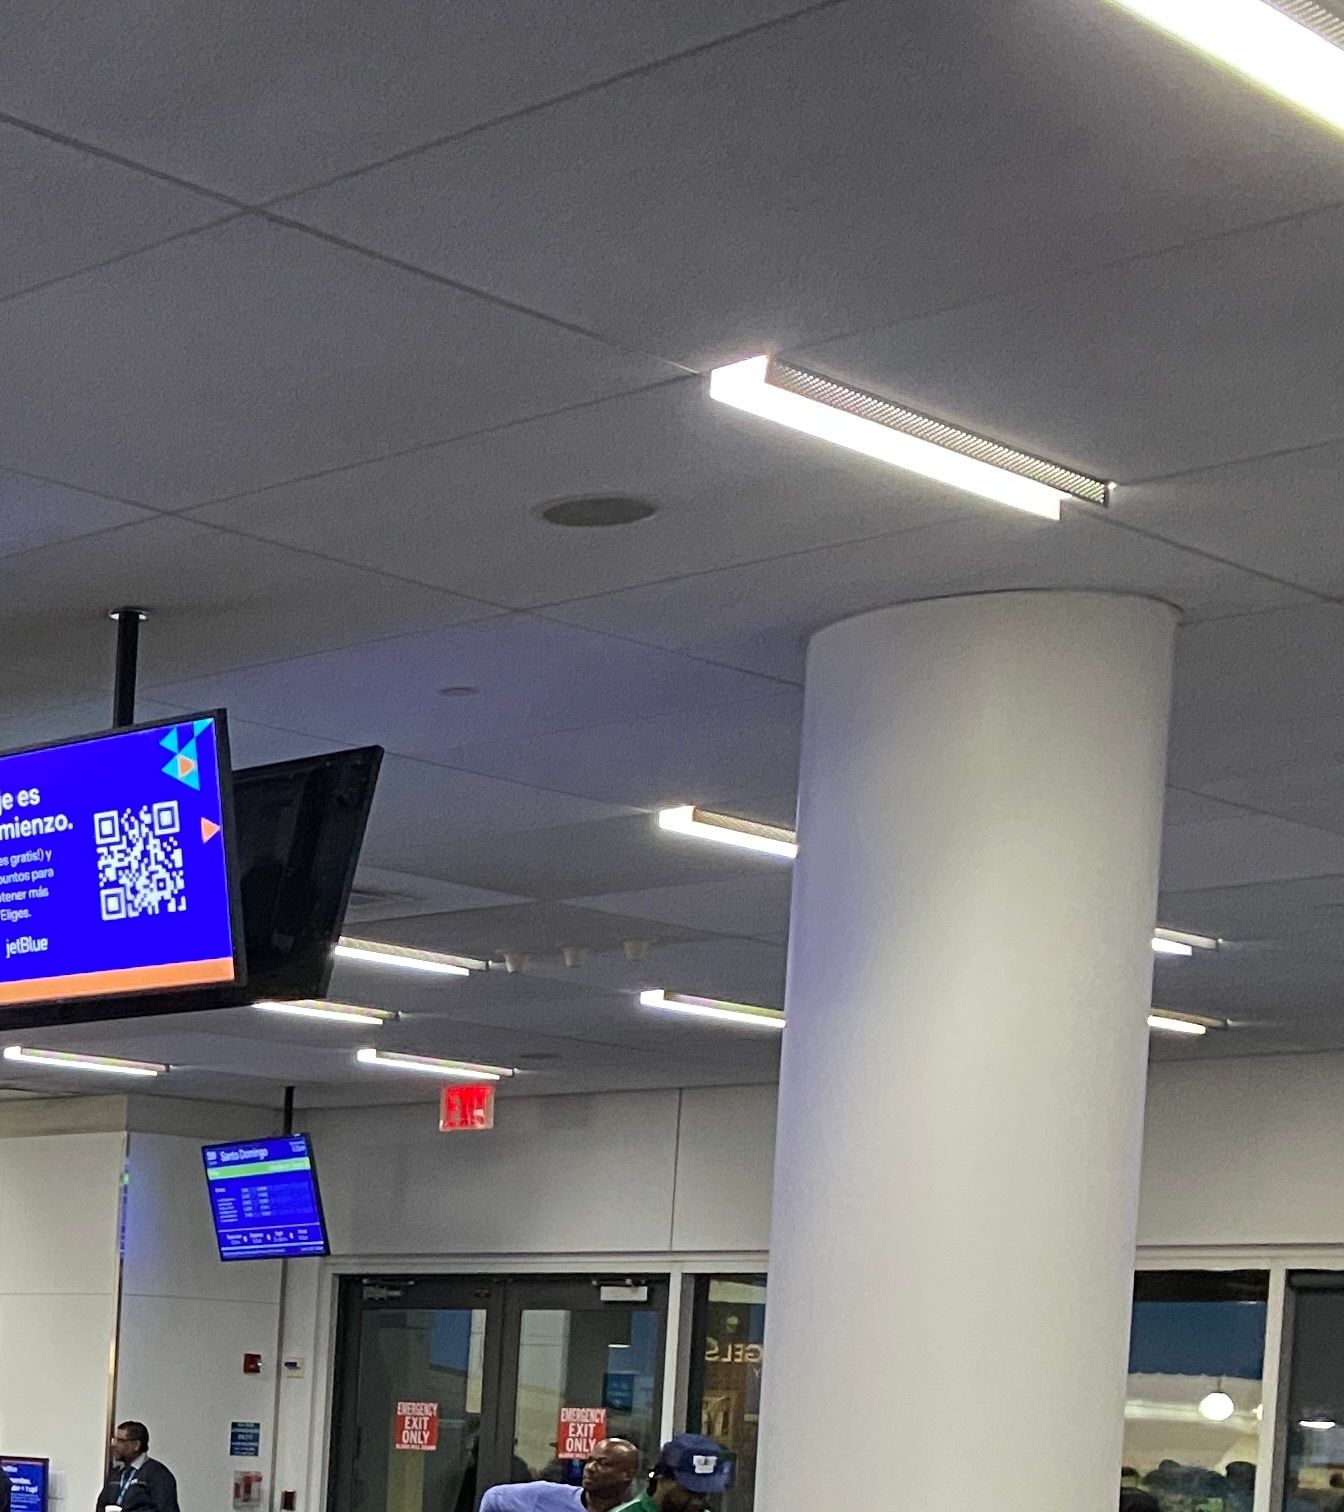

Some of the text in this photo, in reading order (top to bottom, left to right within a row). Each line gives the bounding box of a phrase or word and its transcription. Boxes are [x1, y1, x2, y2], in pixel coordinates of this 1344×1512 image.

[17, 788, 41, 807] es
[10, 848, 44, 867] gratis!)
[45, 850, 52, 862] y
[31, 868, 55, 882] para
[28, 885, 50, 898] más
[0, 908, 32, 922] Eliges.
[5, 935, 49, 958] jetBlue
[397, 1402, 438, 1416] EMERGENCY
[561, 1408, 606, 1423] EMERGENCY
[405, 1416, 430, 1430] EXIT
[402, 1430, 431, 1444] ONLY
[568, 1423, 597, 1438] EXIT
[566, 1438, 597, 1452] ONLY
